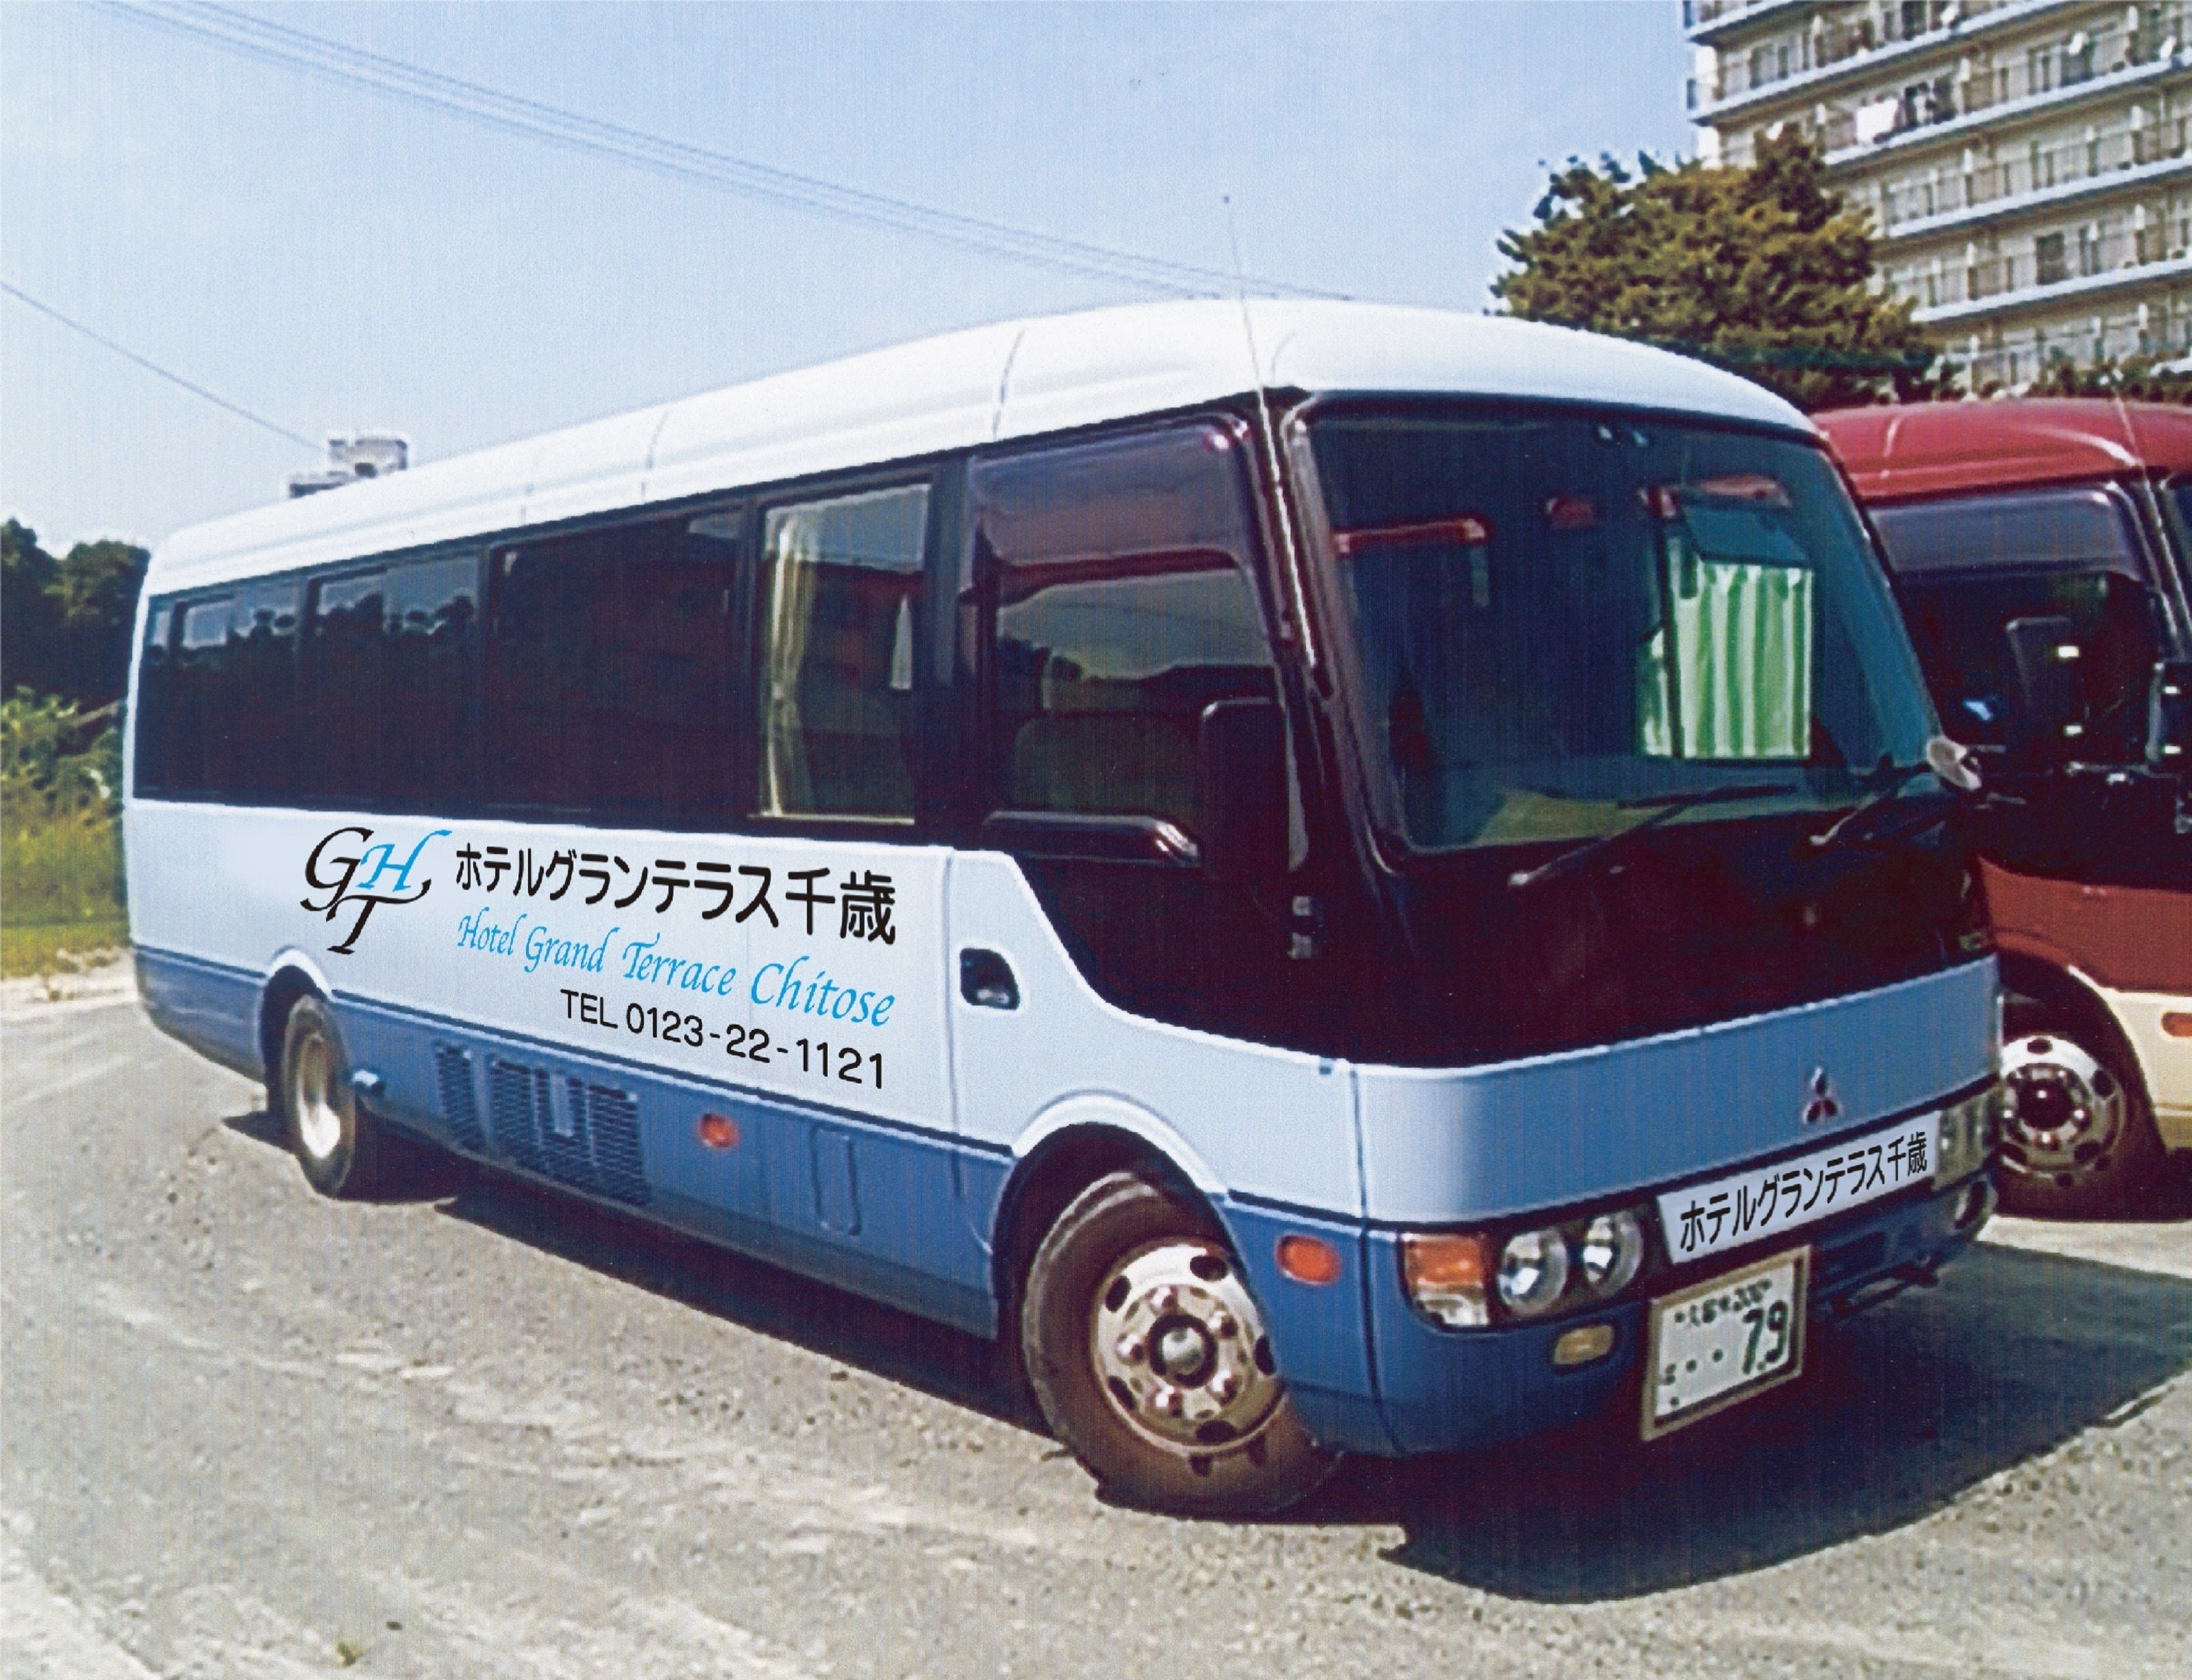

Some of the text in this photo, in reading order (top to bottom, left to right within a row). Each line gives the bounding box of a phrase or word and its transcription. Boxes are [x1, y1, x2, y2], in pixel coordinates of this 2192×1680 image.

[456, 842, 896, 945] ホテルグランテラス千歳
[457, 907, 895, 1027] Hotel Grand Terrace Chitose
[560, 988, 882, 1090] TEL 0123-22-1121
[1680, 1131, 1928, 1252] ホテルグランテラス千歳
